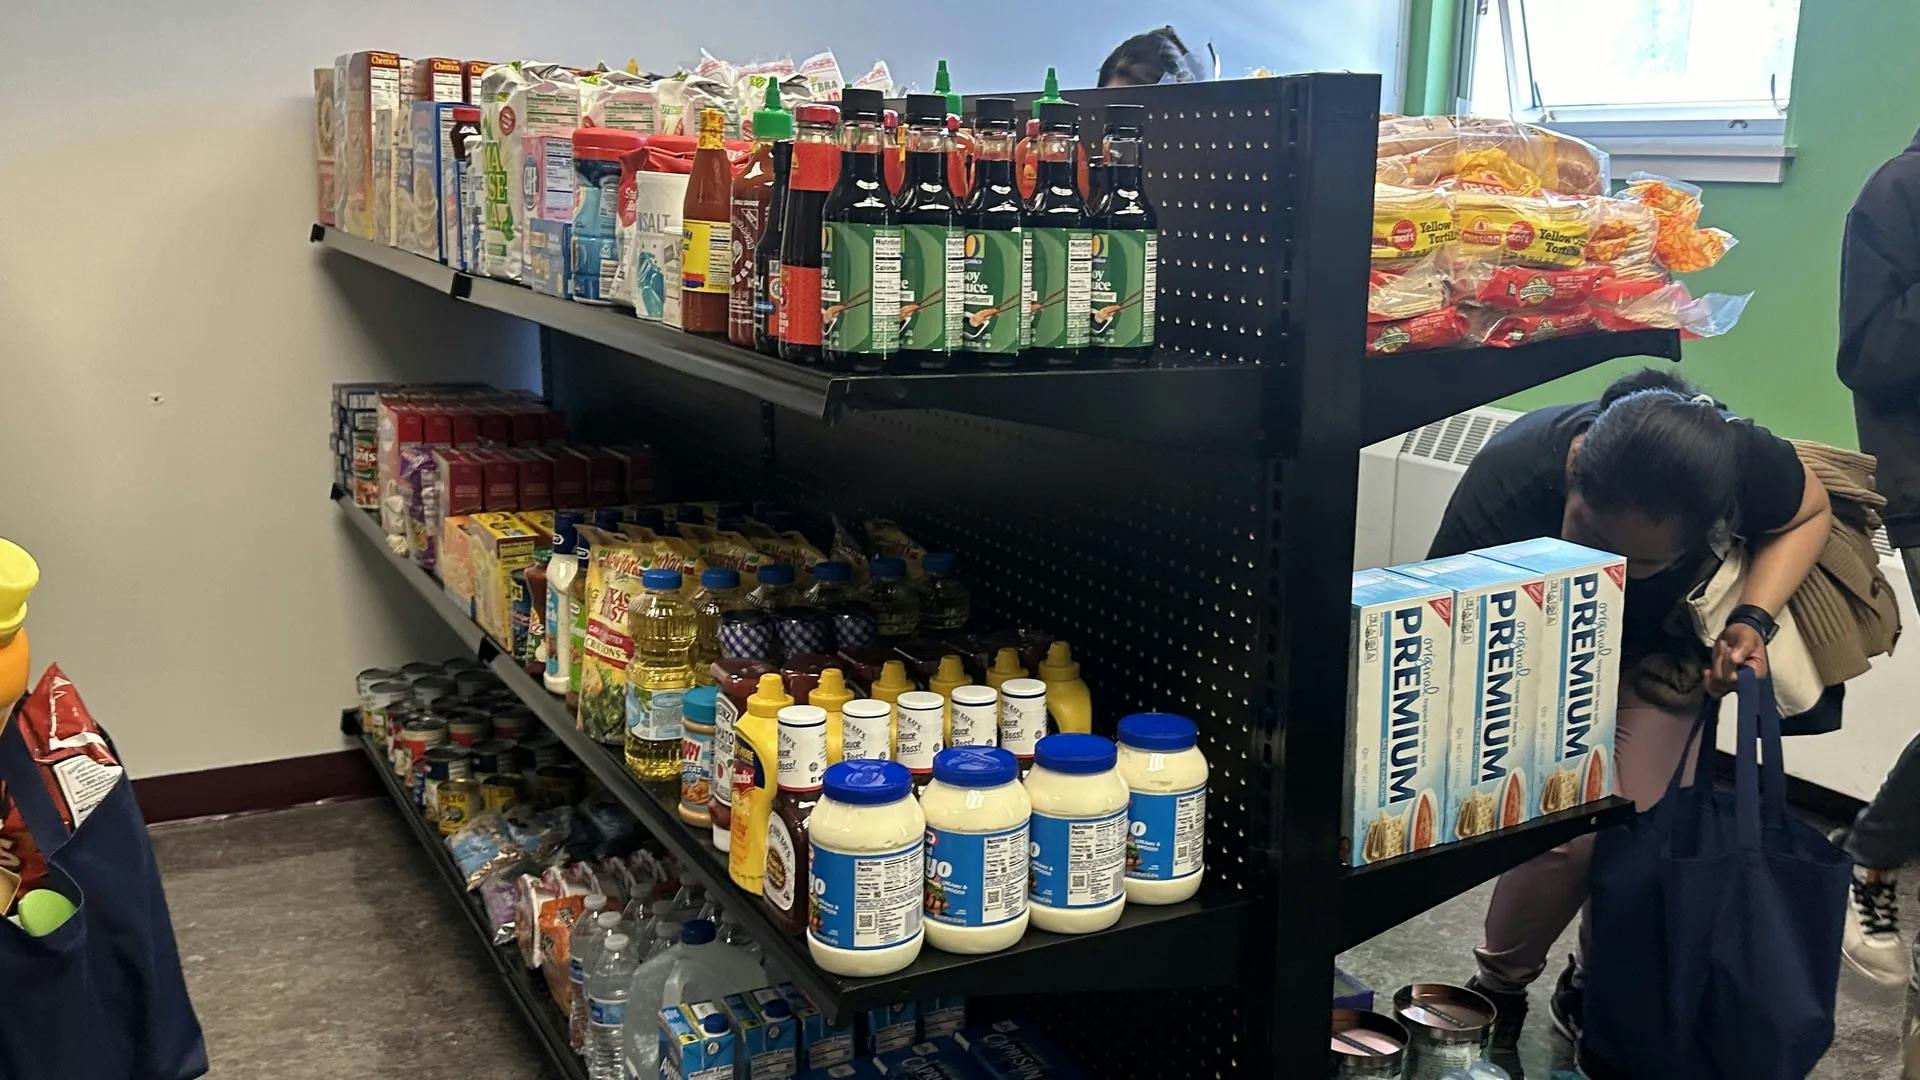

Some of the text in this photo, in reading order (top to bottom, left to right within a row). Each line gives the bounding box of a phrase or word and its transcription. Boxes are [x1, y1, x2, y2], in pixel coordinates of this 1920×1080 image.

[1420, 221, 1451, 233] Yellow
[1507, 621, 1530, 677] original
[1590, 602, 1611, 656] original
[1415, 637, 1439, 695] original
[1482, 590, 1516, 783] PREMIUM
[1565, 572, 1599, 760] PREMIUM
[1389, 606, 1423, 804] PREMIUM
[901, 742, 922, 753] Boss!
[924, 855, 952, 879] yo
